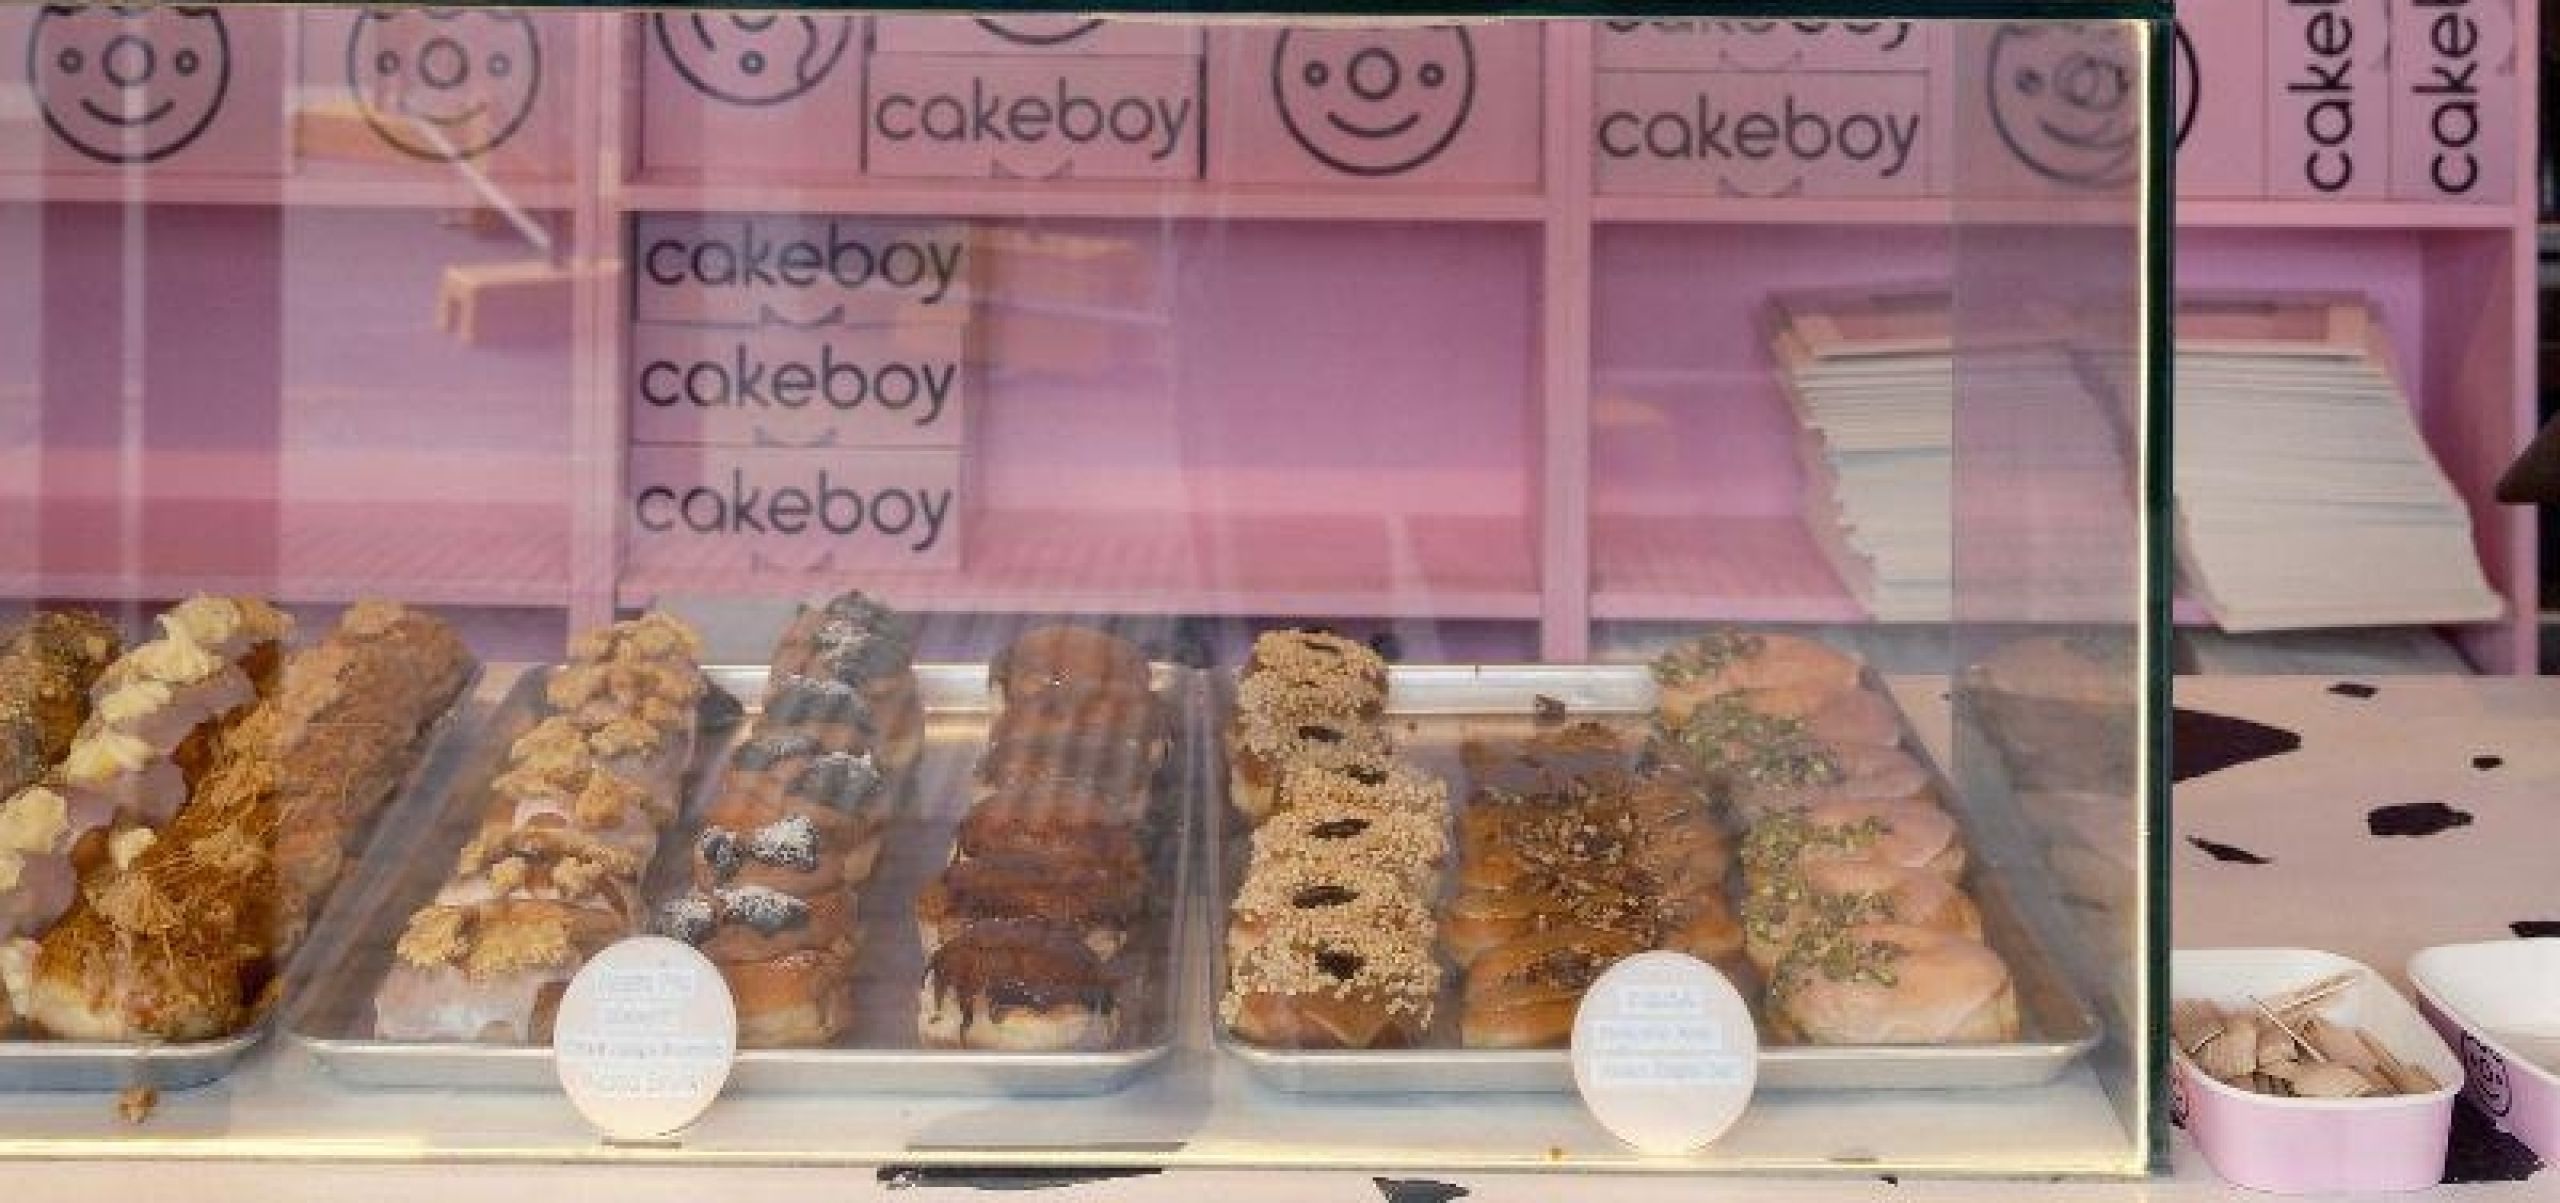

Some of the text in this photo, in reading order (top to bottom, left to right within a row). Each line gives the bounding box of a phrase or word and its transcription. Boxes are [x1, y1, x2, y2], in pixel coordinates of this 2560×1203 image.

[875, 76, 1191, 161] cakeboy
[1598, 92, 1921, 178] cakeboy
[2286, 0, 2353, 192] cake
[2411, 0, 2479, 194] cake
[645, 220, 963, 304] cakeboy
[639, 343, 956, 426] cakeboy
[636, 467, 952, 552] cakeboy
